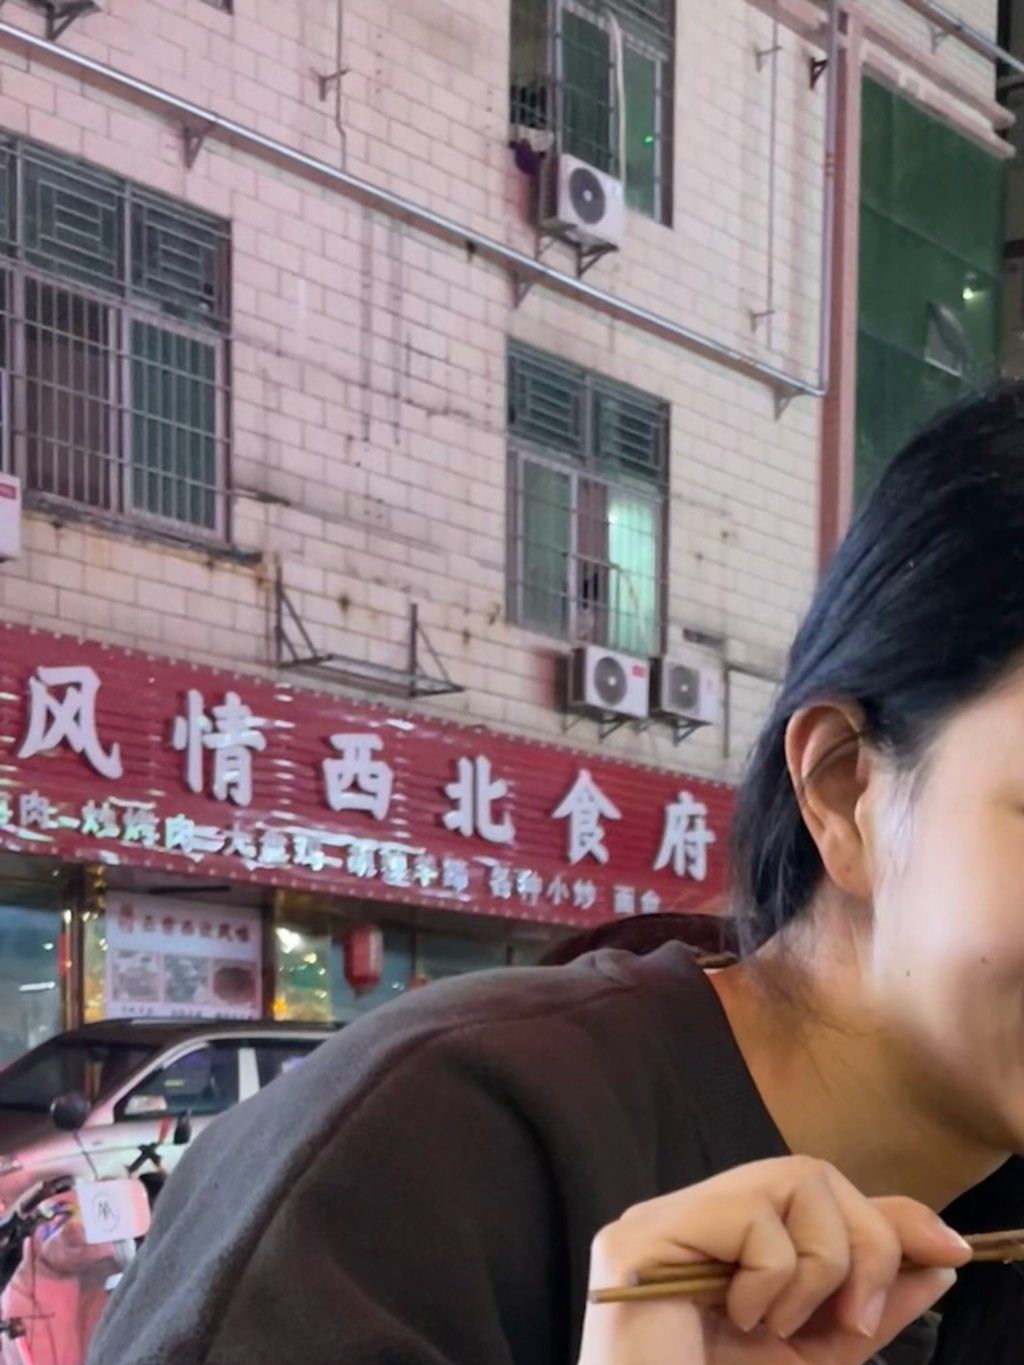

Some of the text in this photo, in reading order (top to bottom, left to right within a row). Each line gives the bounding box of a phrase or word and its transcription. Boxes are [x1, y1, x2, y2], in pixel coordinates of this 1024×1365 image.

[17, 665, 716, 882] 风情西北食府
